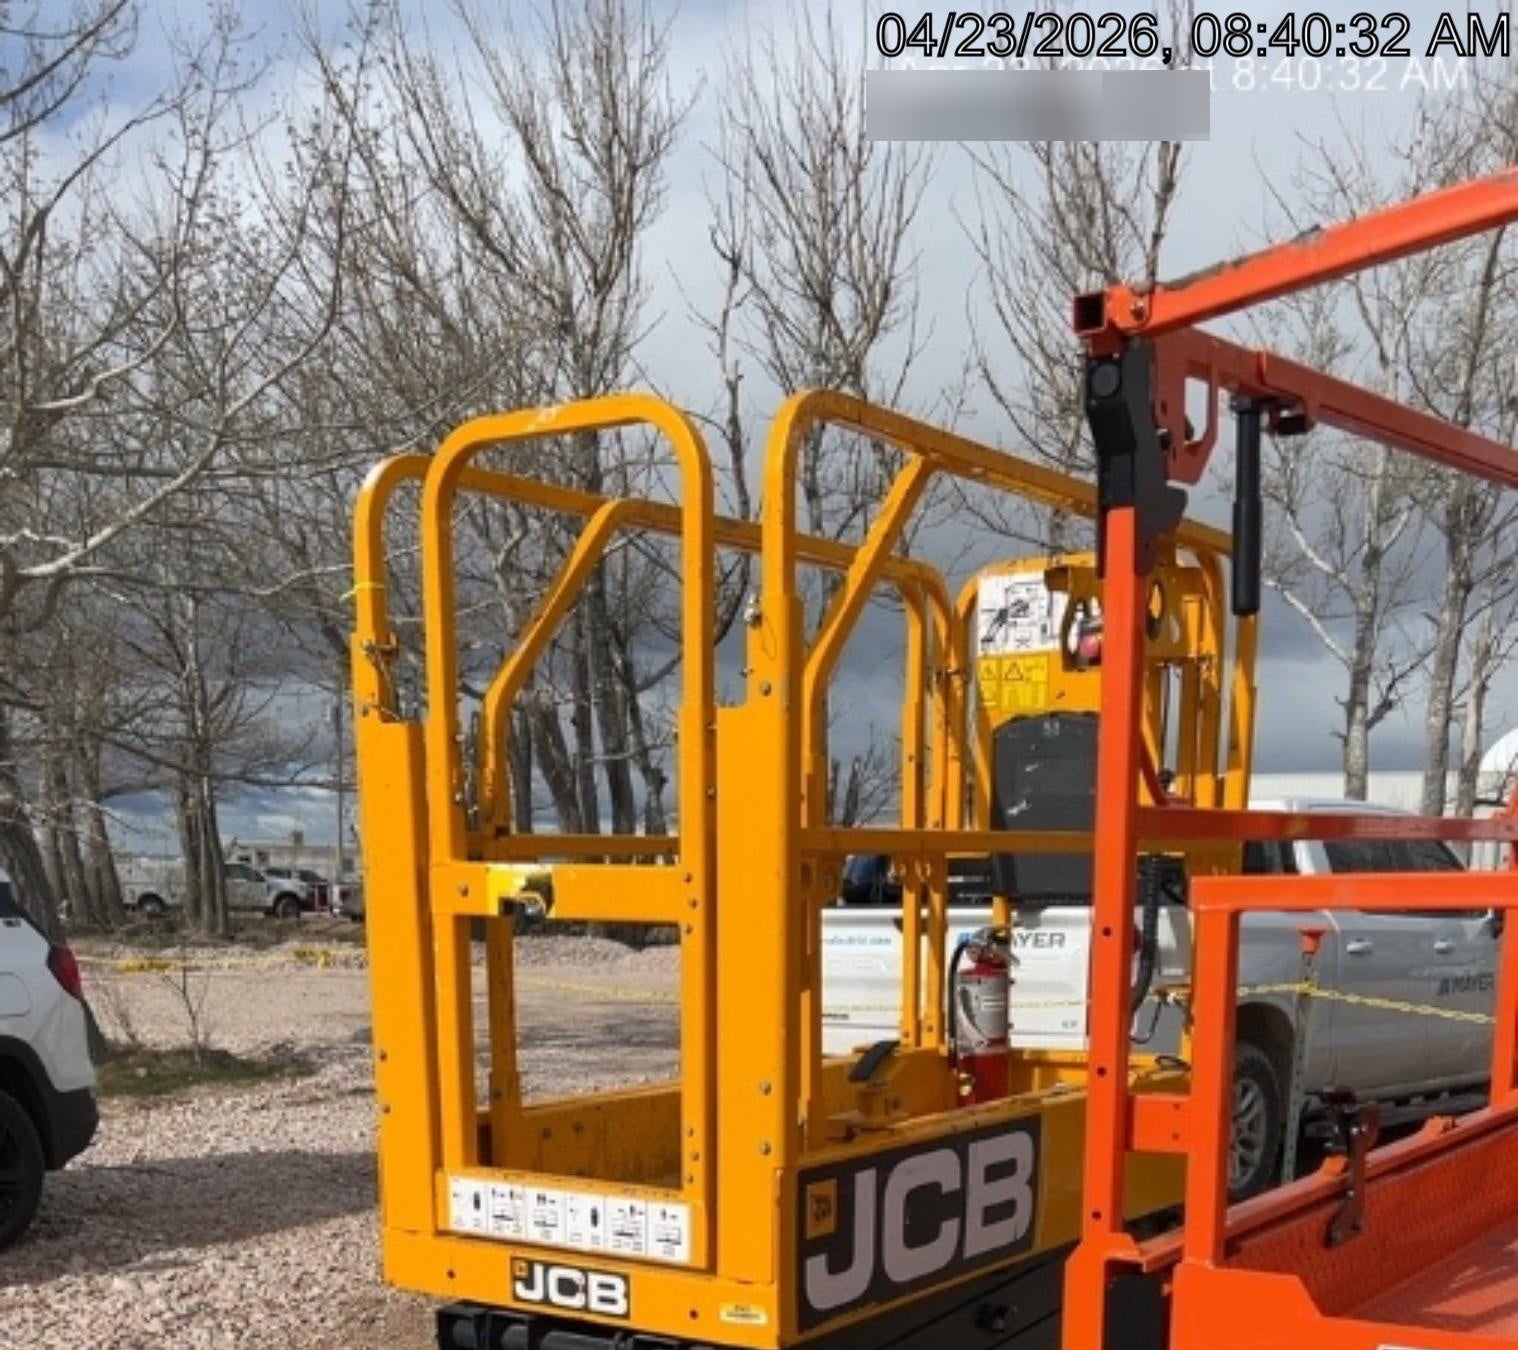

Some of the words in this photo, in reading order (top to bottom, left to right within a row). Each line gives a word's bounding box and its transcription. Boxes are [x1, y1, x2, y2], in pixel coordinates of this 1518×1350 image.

[1014, 932, 1066, 948] YER
[805, 1130, 1034, 1310] JCB
[515, 1262, 628, 1316] JCB
